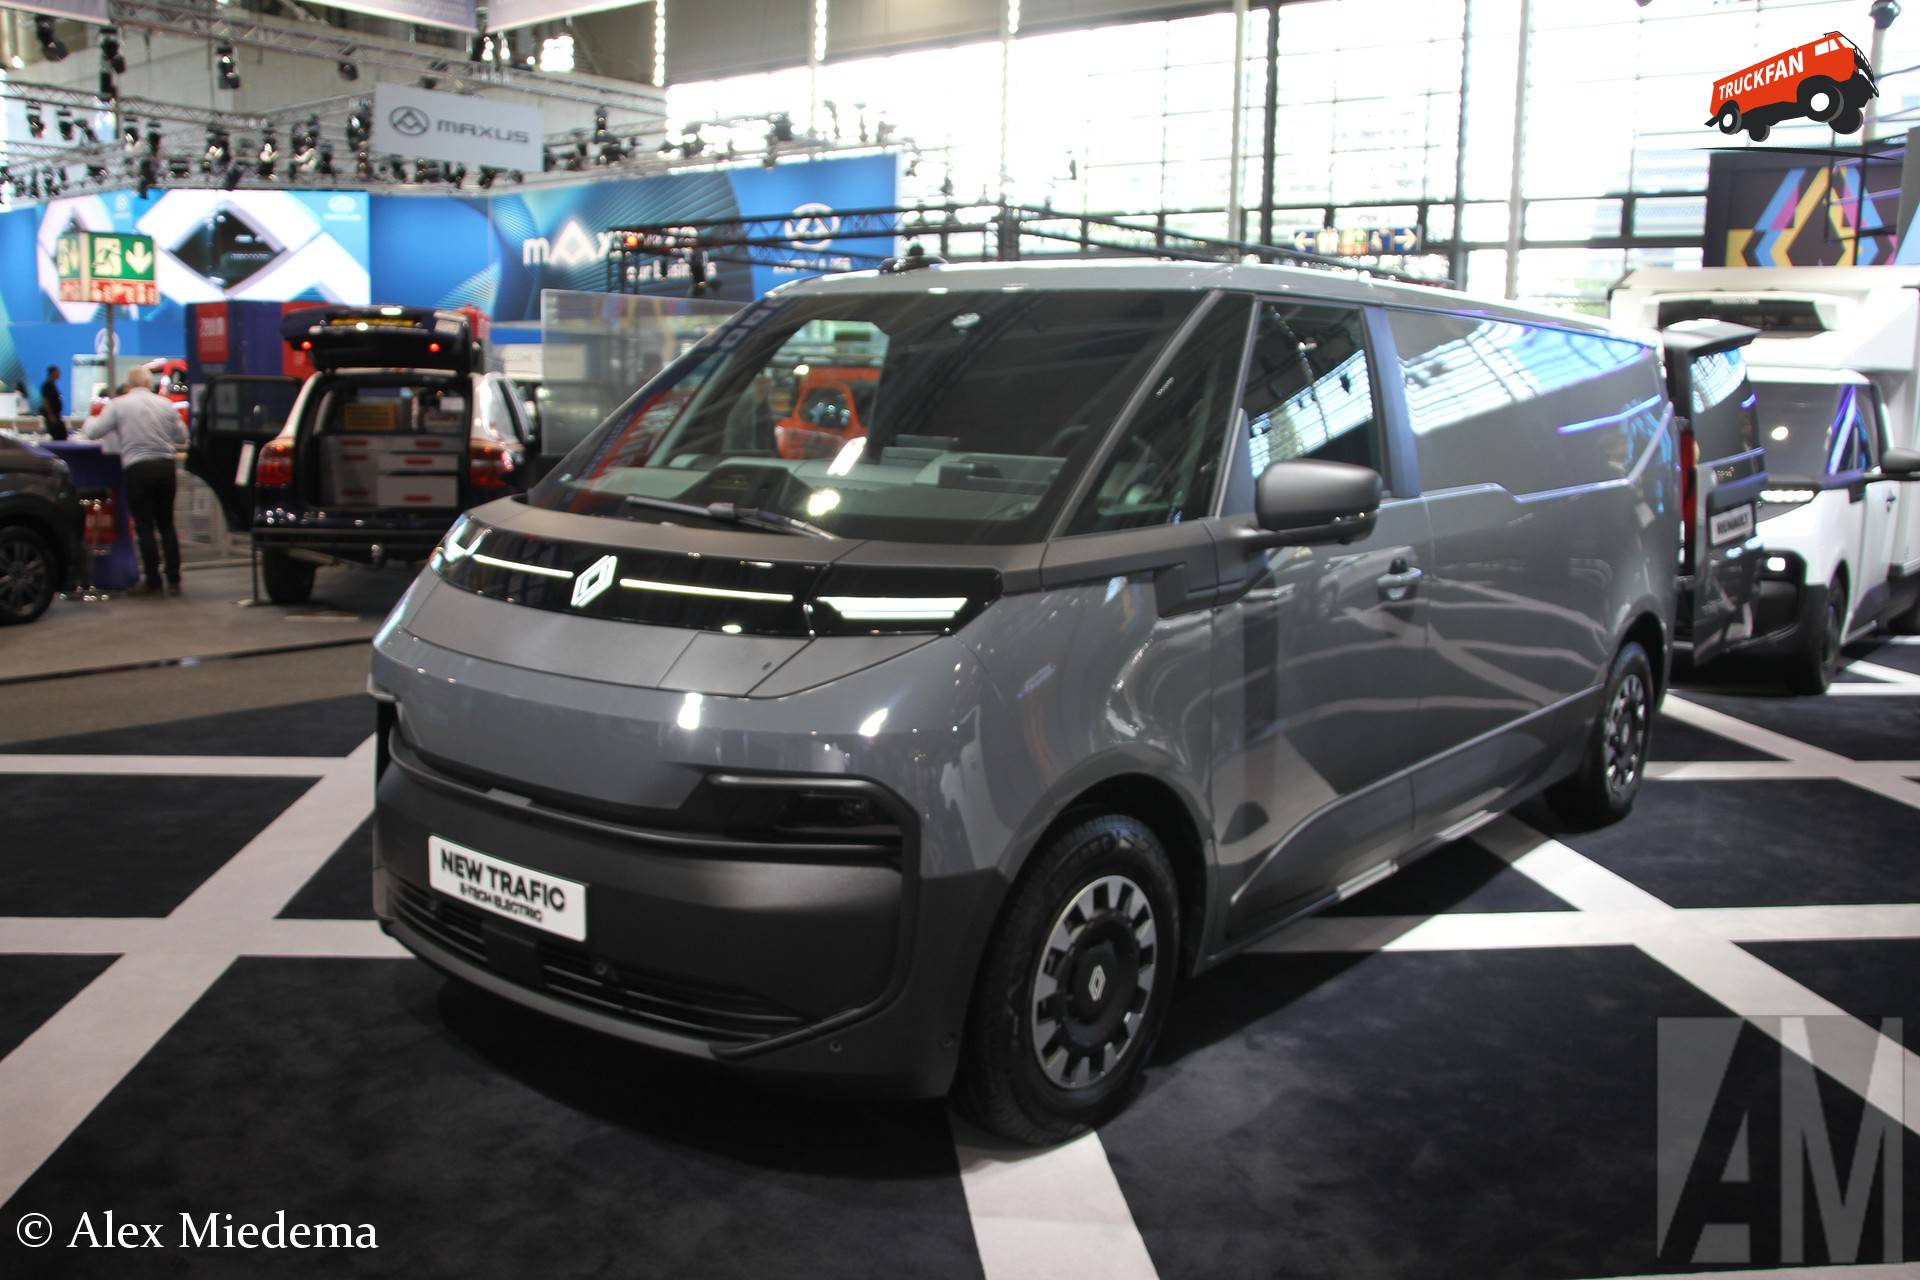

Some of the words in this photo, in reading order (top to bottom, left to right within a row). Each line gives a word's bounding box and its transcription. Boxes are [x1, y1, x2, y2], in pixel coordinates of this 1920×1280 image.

[436, 119, 530, 144] MAXUS
[440, 848, 483, 884] NEW
[486, 865, 566, 913] TRAFIC
[493, 895, 543, 923] ELECTRIC
